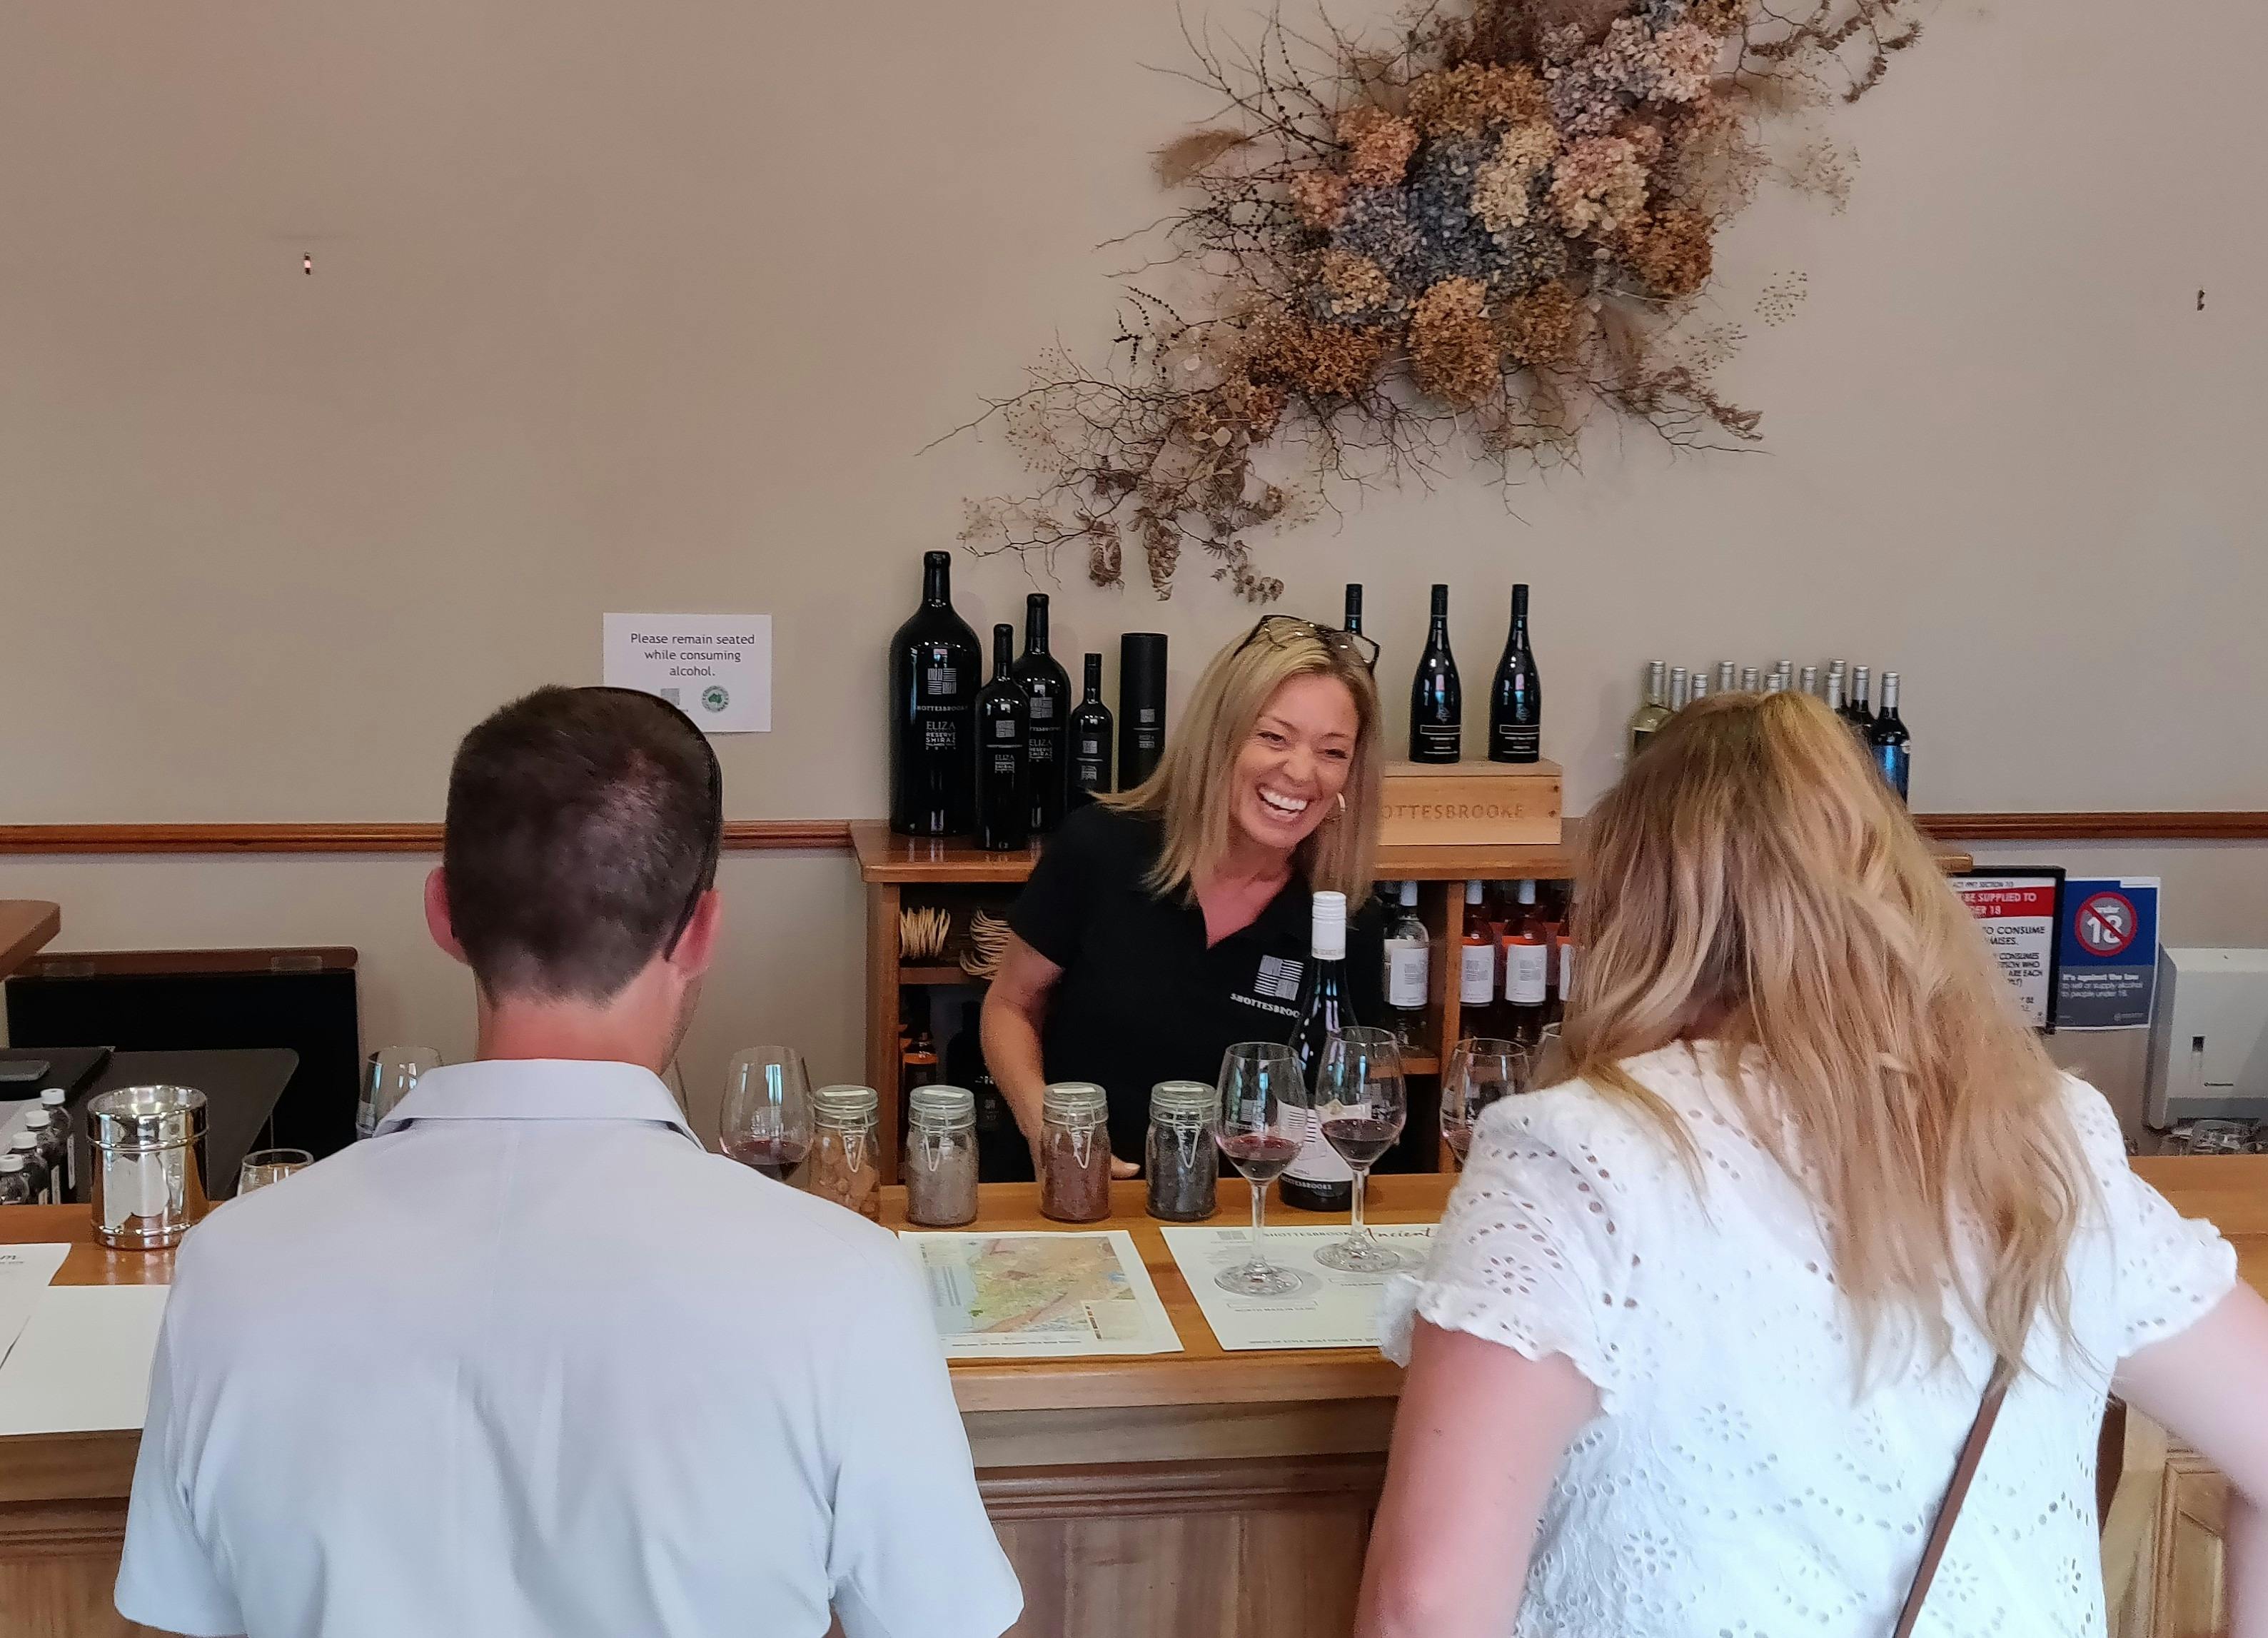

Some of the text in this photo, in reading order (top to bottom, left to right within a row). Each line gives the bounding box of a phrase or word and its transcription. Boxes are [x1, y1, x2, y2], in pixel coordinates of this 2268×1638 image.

[630, 633, 755, 644] Please remain seated
[645, 650, 741, 663] while consuming
[670, 666, 715, 676] alcohol.
[927, 721, 956, 730] ELIZA
[1977, 893, 2021, 903] SUPPLIED
[2023, 892, 2037, 902] TO
[1997, 926, 2045, 935] CONSUME
[2087, 915, 2123, 944] 18
[1361, 1227, 1435, 1244] Ancient
